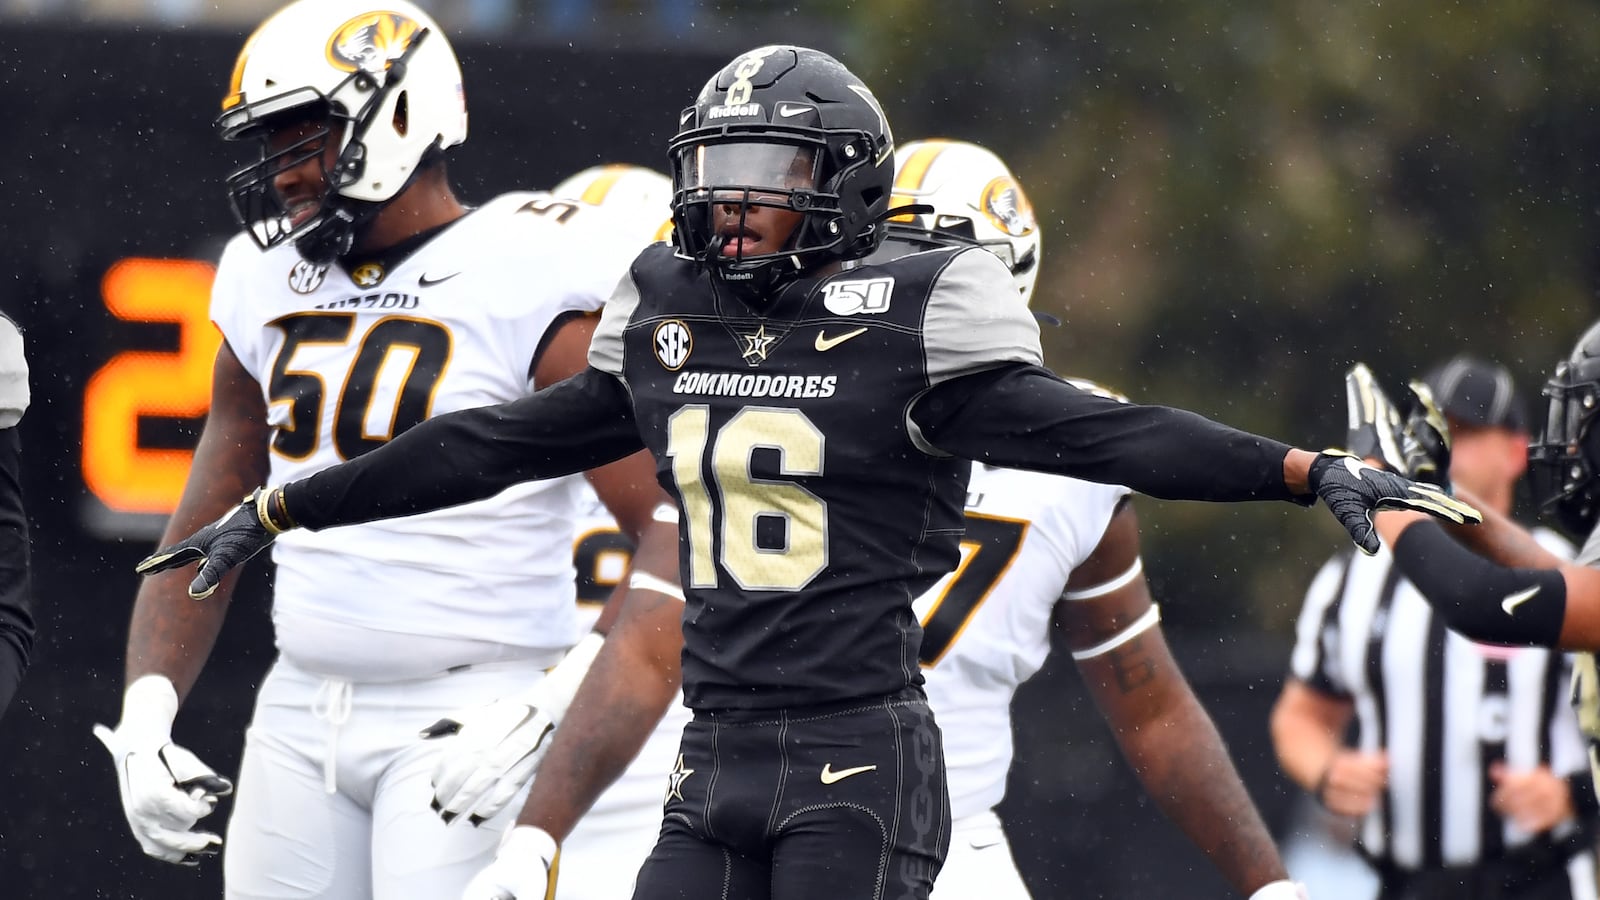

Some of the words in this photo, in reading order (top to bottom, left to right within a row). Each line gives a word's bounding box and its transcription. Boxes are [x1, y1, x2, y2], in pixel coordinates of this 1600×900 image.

[709, 104, 760, 119] Riddell
[290, 260, 327, 293] SEC
[726, 273, 752, 281] Riddell
[314, 293, 419, 310] IZZOU
[821, 277, 895, 316] 150
[656, 323, 690, 367] SEC
[79, 258, 223, 514] 2
[264, 311, 454, 463] 50
[673, 372, 838, 398] COMMODORES
[667, 404, 829, 591] 16
